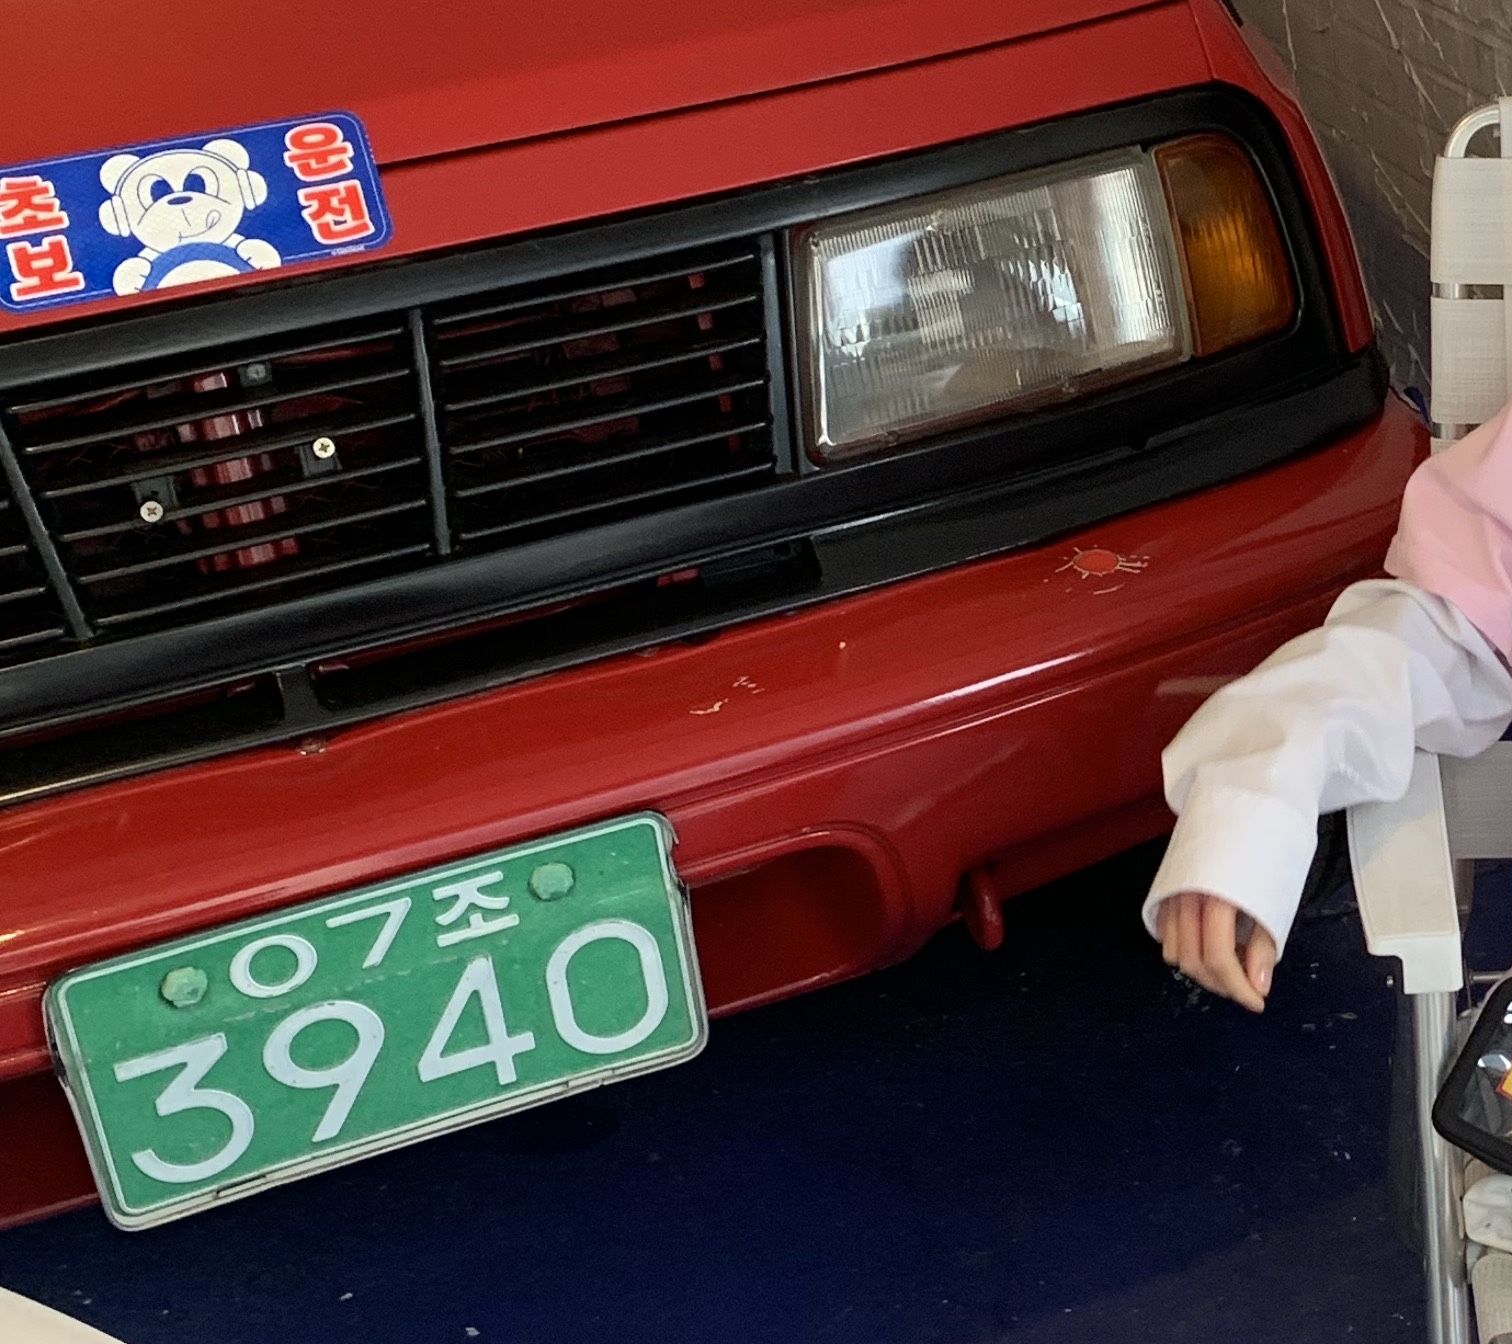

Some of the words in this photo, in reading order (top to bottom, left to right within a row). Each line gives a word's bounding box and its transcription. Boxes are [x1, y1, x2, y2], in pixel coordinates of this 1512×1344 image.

[0, 174, 84, 301] 초보
[284, 122, 374, 244] 운전
[113, 918, 670, 1183] 3940
